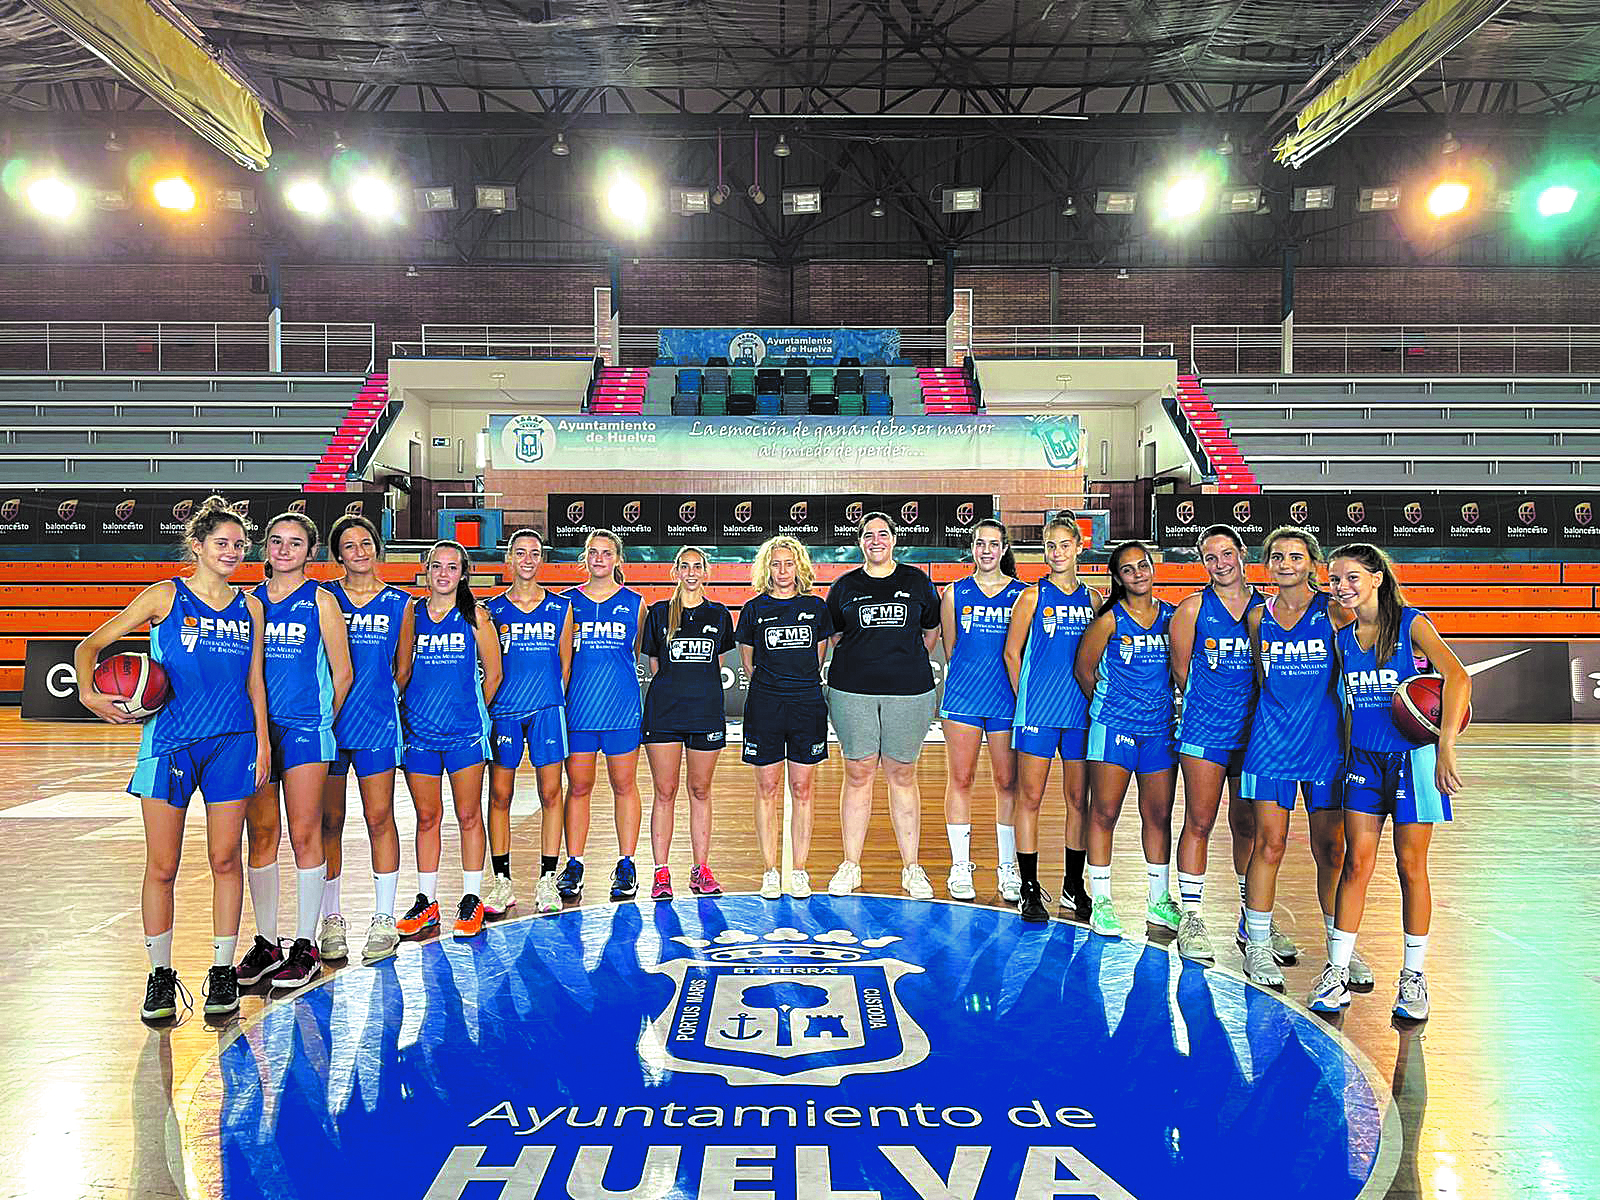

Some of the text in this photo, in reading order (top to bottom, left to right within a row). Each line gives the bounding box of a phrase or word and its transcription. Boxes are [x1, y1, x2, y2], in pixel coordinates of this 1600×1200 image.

[767, 337, 832, 345] Ayuntamiento
[785, 345, 832, 353] de Huelva
[557, 420, 656, 432] Ayuntamiento
[689, 420, 716, 436] La
[719, 421, 788, 437] emoción
[792, 420, 809, 442] de
[814, 424, 868, 444] ganar
[871, 417, 907, 442] debe
[911, 424, 934, 436] ser
[586, 432, 656, 443] de Huelva
[264, 622, 307, 646] MB
[511, 622, 556, 641] FMB
[581, 621, 627, 640] FMB
[417, 632, 466, 653] FMB
[1270, 639, 1328, 662] FMB
[675, 979, 707, 1041] PORTUS MARIS
[863, 988, 888, 1029] CUSTODIA
[467, 1100, 1097, 1136] Ayuntamiento de
[421, 1145, 1140, 1200] HUELVA
